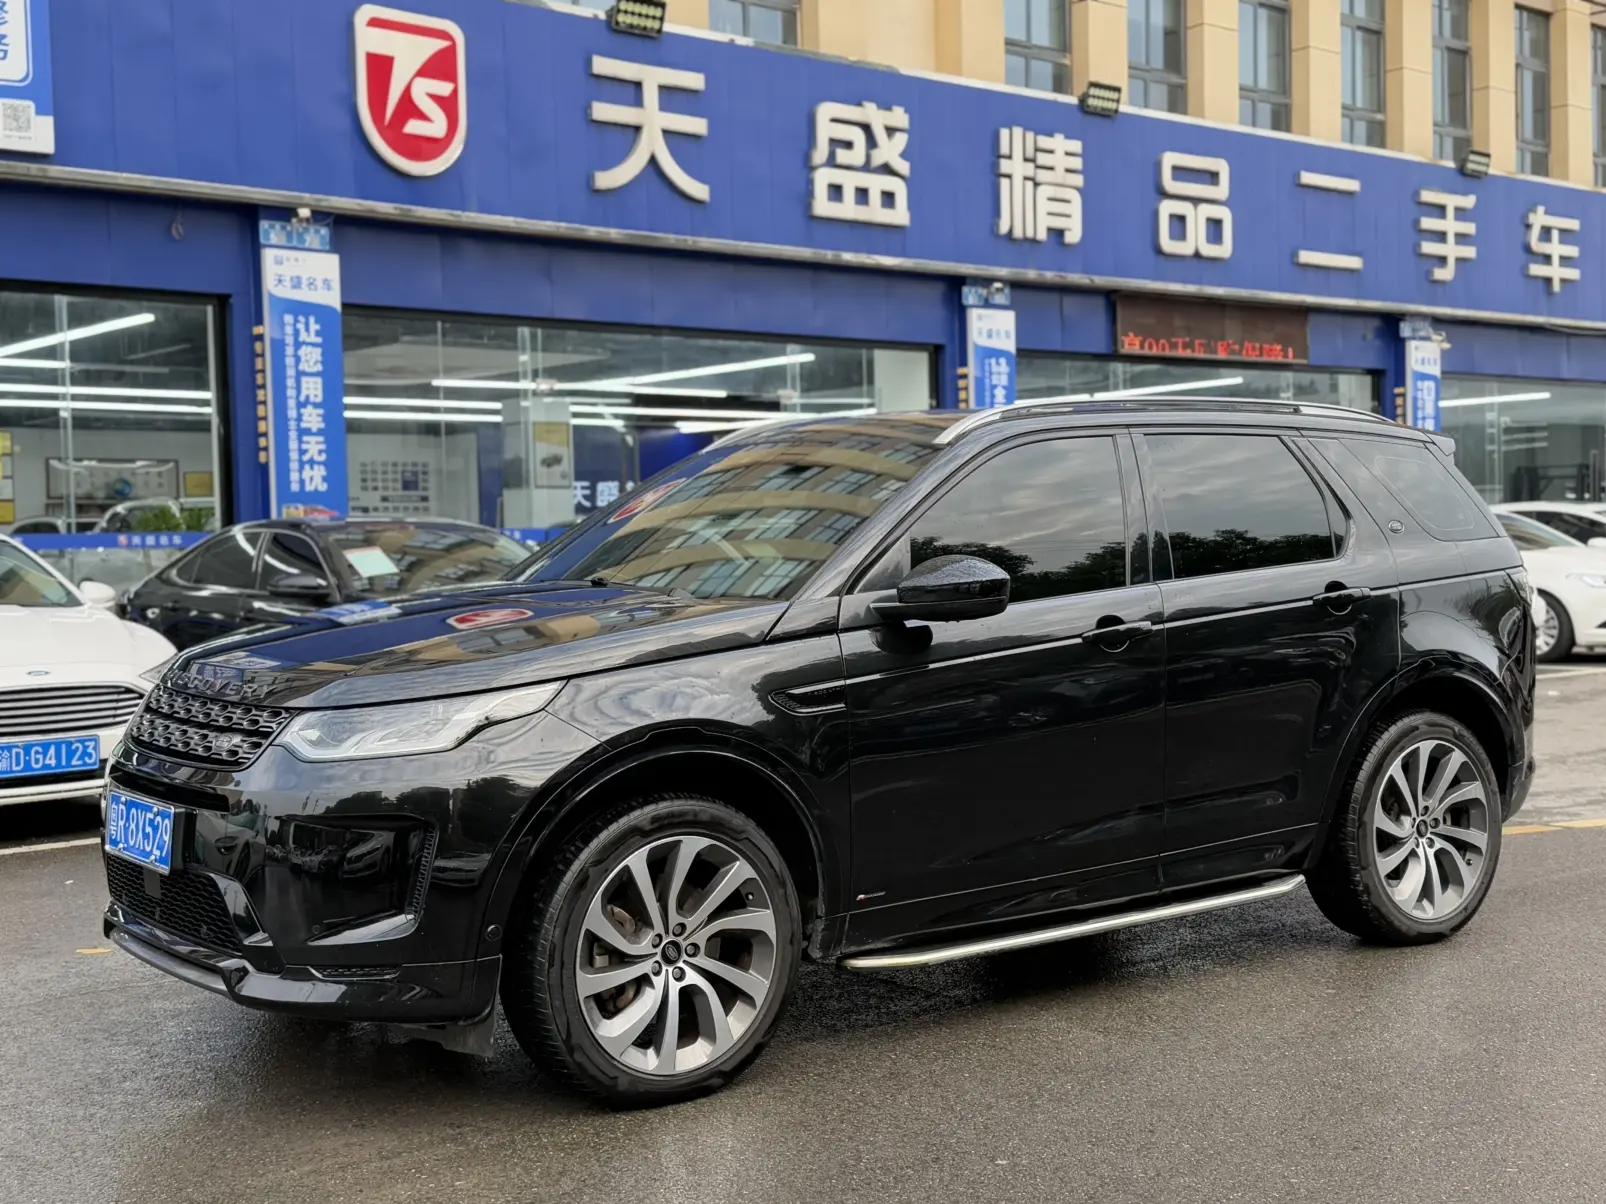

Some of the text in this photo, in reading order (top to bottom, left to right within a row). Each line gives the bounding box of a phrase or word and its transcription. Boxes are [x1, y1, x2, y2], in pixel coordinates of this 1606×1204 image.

[589, 54, 1581, 294] 天盛精品二手车
[273, 273, 335, 292] 天盛名车
[296, 315, 329, 493] 让您用车无忧
[166, 668, 278, 699] DISCOVERY
